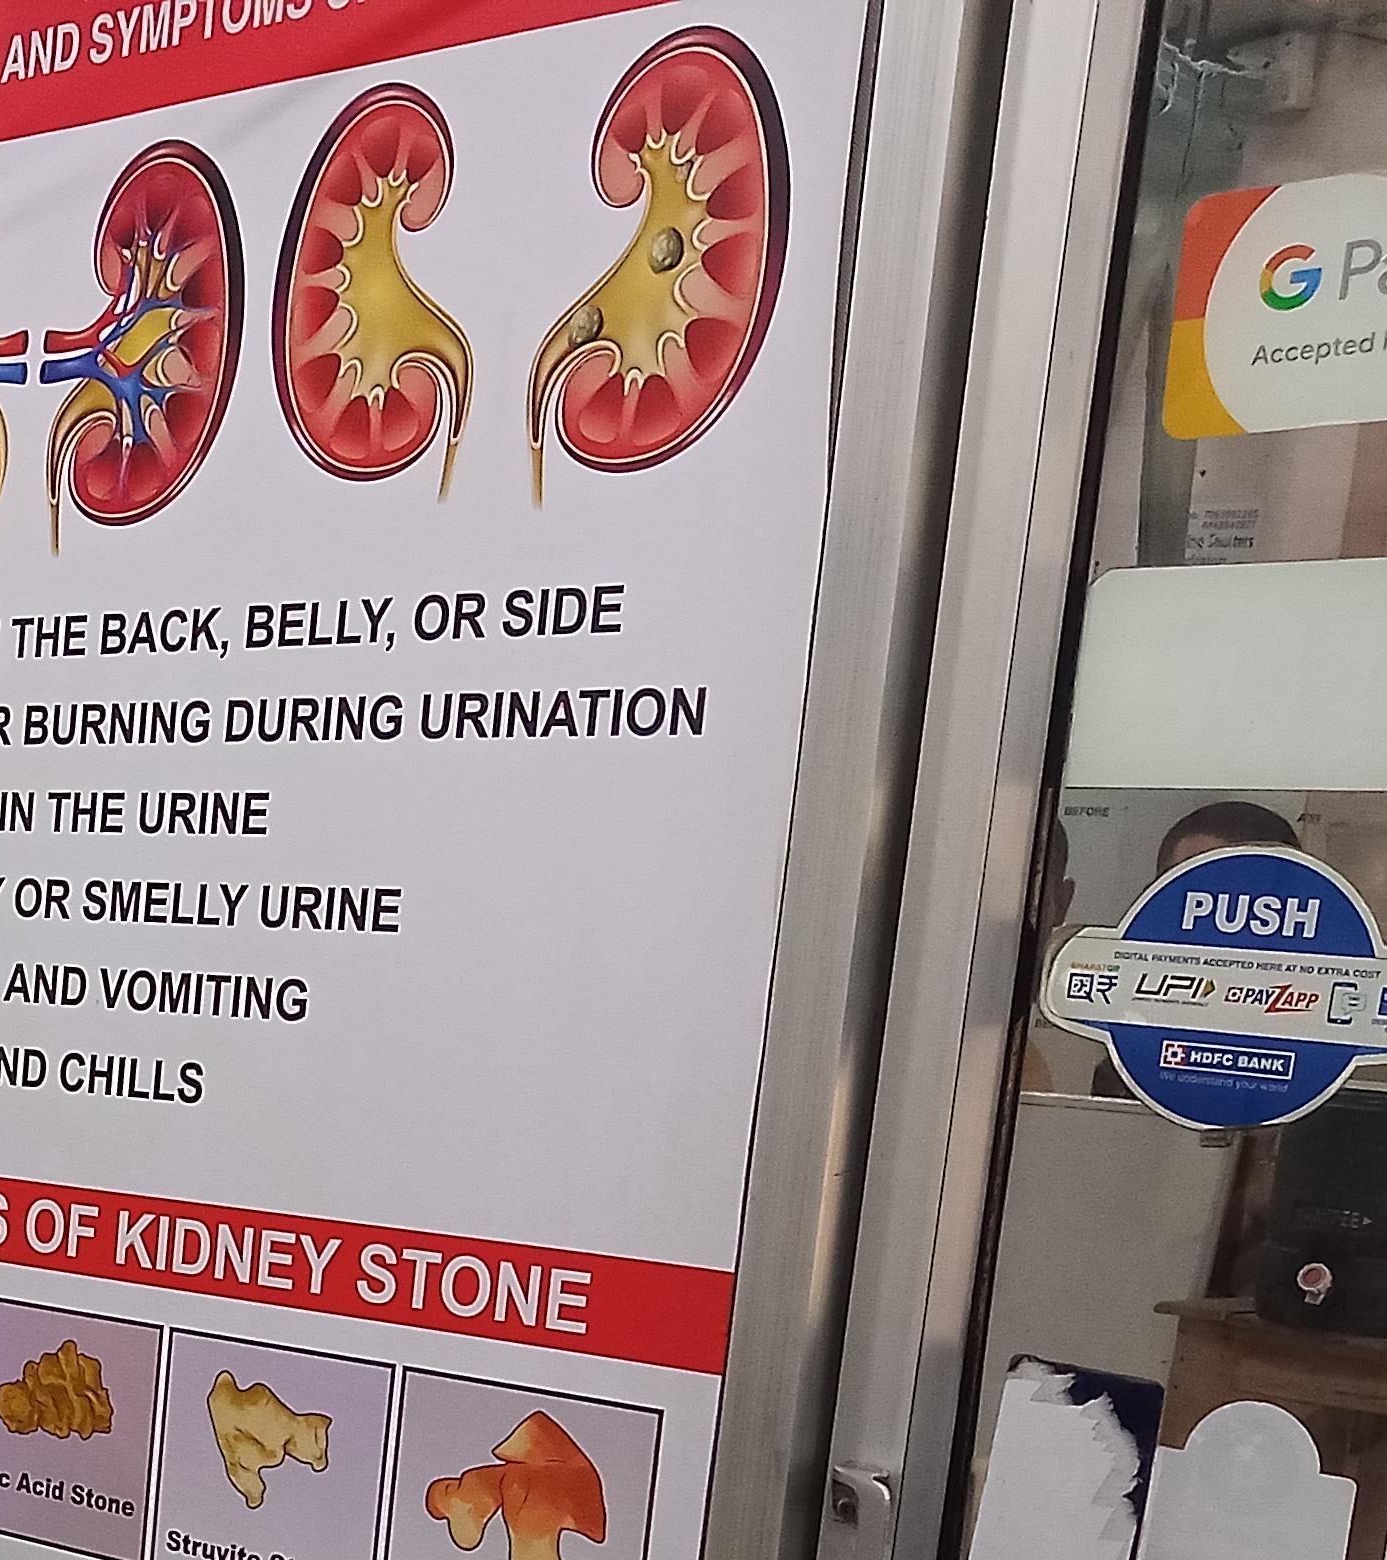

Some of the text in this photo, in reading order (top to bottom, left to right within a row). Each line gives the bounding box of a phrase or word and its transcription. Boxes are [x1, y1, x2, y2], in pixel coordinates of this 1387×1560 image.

[0, 22, 80, 84] AND
[1260, 244, 1323, 312] G
[1251, 332, 1376, 366] Accepted
[11, 614, 88, 659] THE
[100, 607, 229, 659] BACK,
[245, 597, 395, 652] BELLY,
[414, 592, 486, 641] OR
[502, 584, 625, 638] SIDE
[23, 700, 211, 746] BURNING
[224, 694, 403, 743] DURING
[421, 686, 707, 740] URINATION
[47, 791, 126, 833] THE
[139, 792, 270, 835] URINE
[15, 877, 70, 920] OR
[82, 880, 249, 927] SMELLY
[260, 885, 402, 933] URINE
[1181, 891, 1321, 938] PUSH
[3, 963, 87, 1006] AND
[100, 967, 308, 1022] VOMITING
[1135, 973, 1207, 999] UPI
[59, 1052, 204, 1104] CHILLS
[1189, 1050, 1285, 1072] HDFC BANK
[26, 1199, 99, 1258] OF
[115, 1210, 343, 1295] KIDNEY
[356, 1243, 592, 1334] STONE
[15, 1472, 65, 1502] Acid
[70, 1484, 135, 1517] Stone
